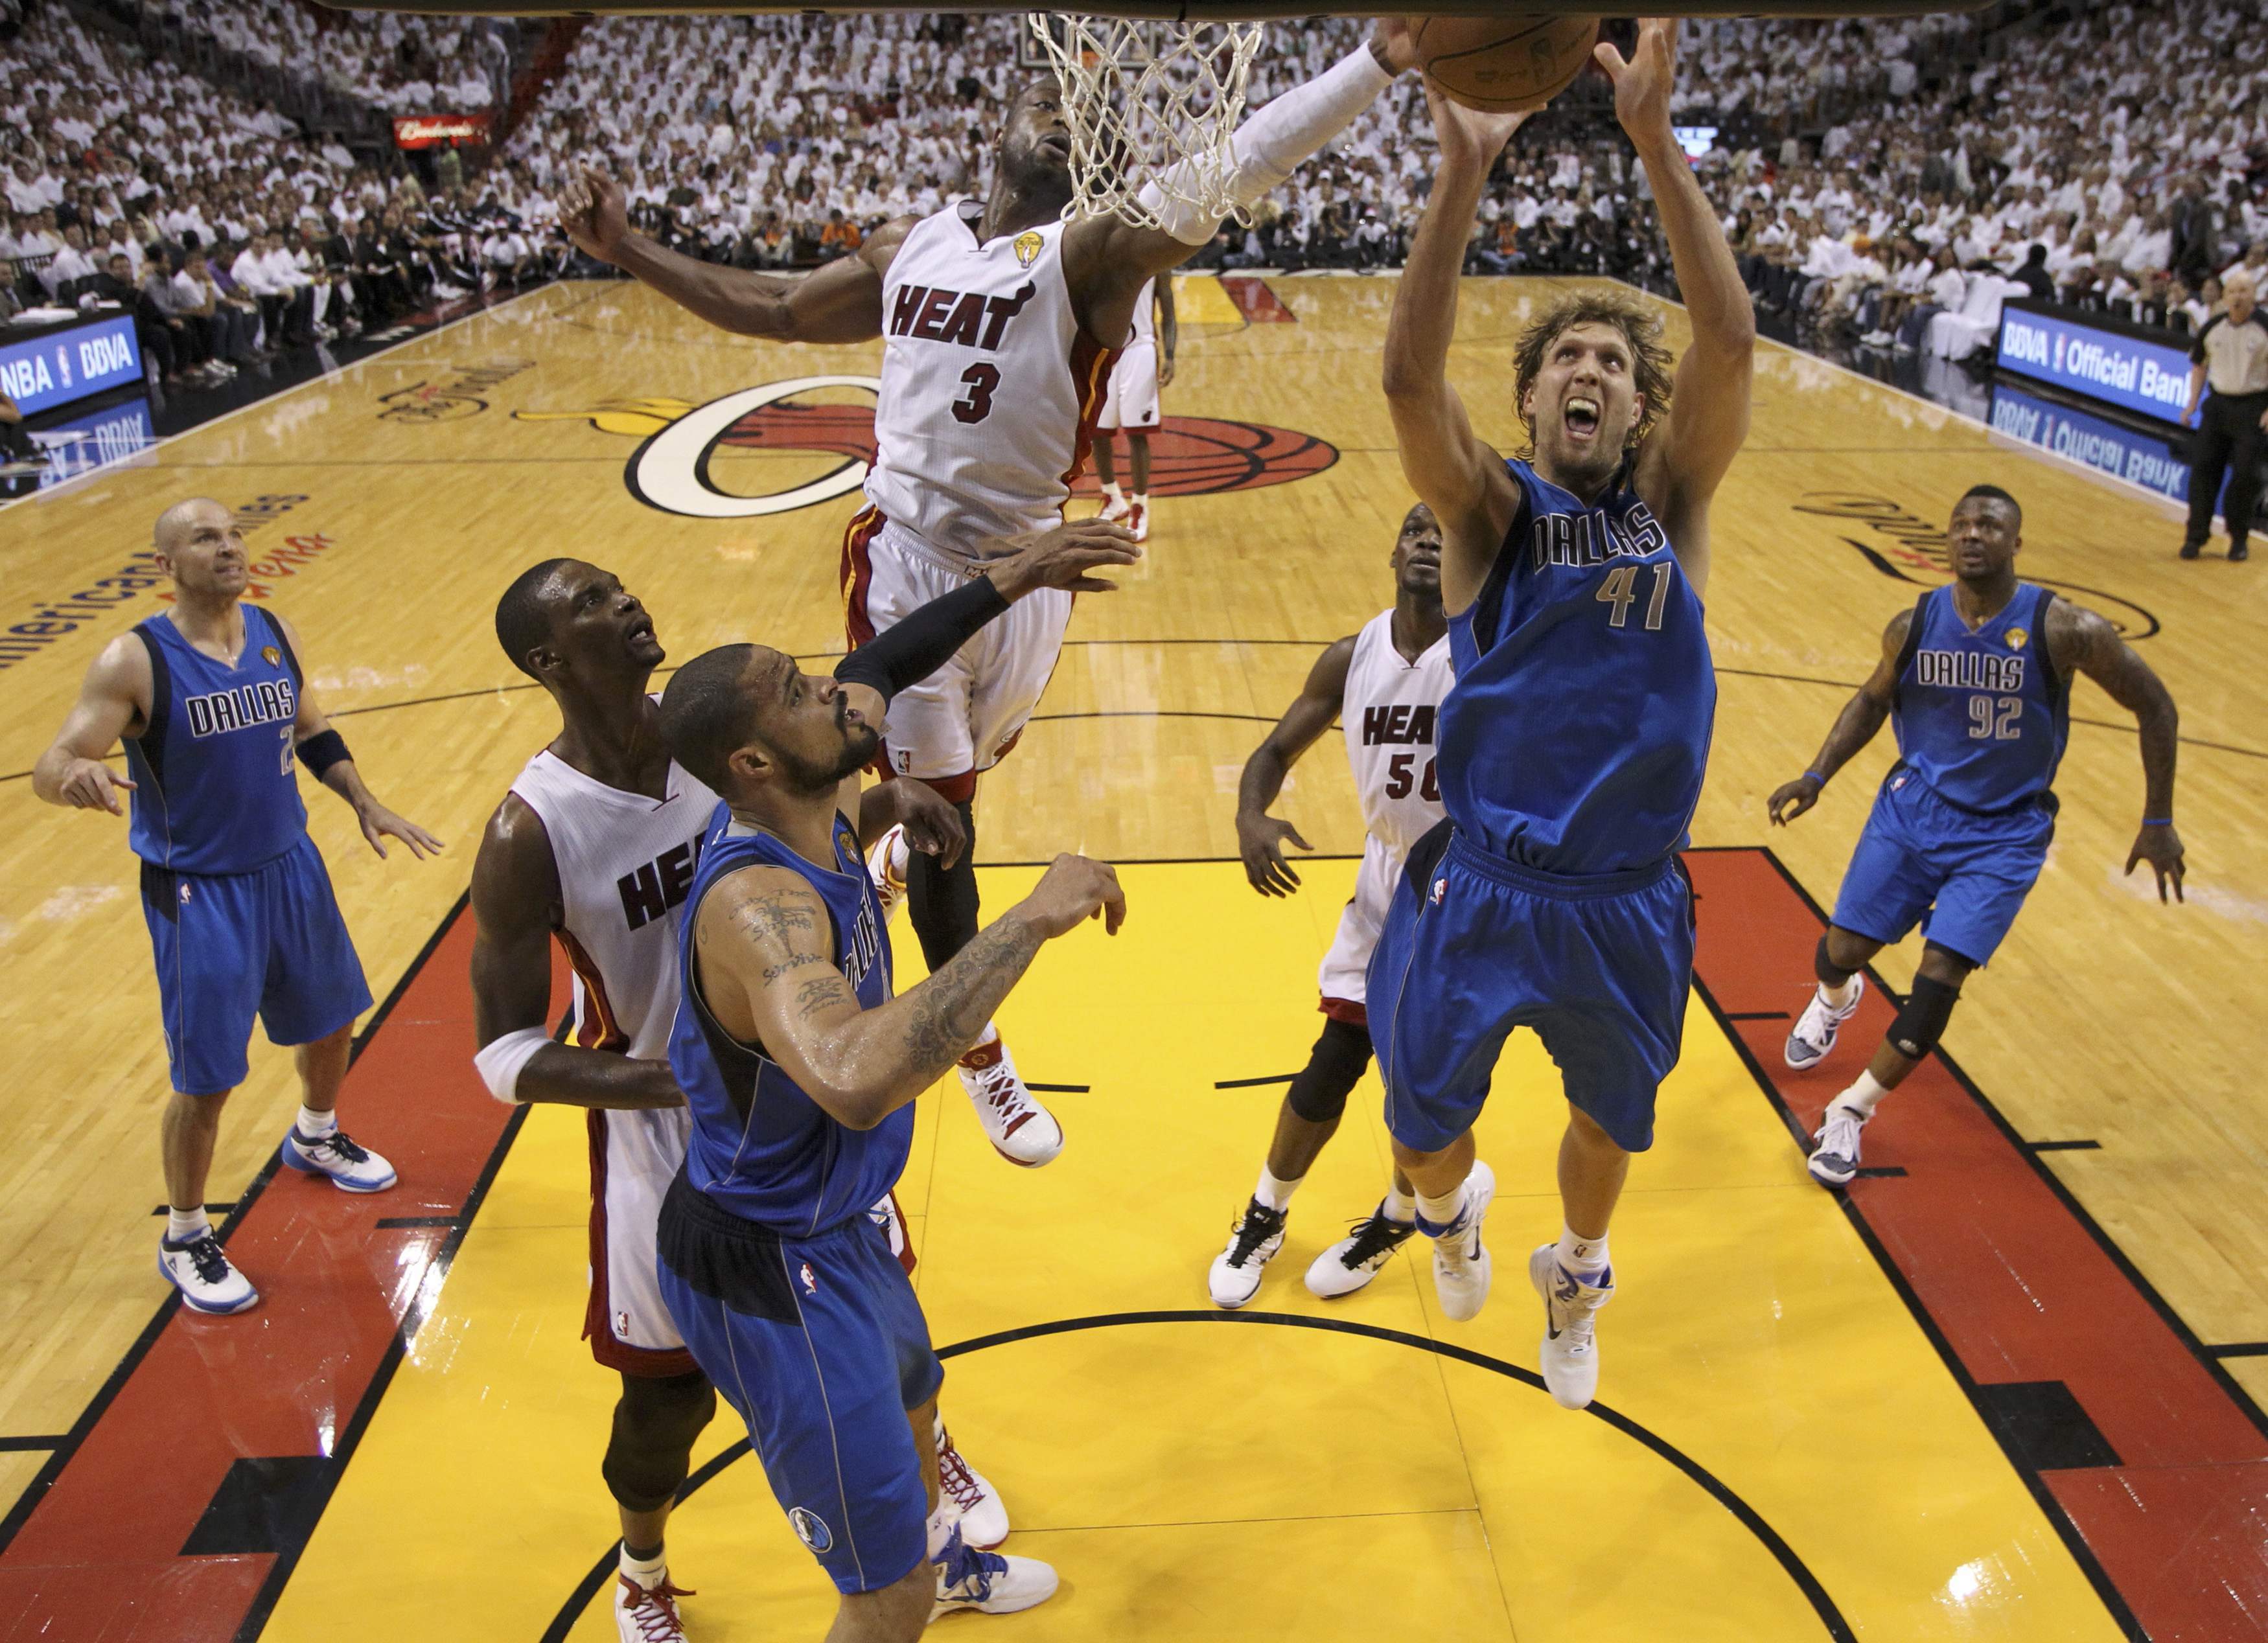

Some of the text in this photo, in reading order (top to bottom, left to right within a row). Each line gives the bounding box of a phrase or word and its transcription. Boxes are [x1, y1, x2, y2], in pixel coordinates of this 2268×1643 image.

[890, 280, 1036, 351] HEAT
[0, 332, 133, 400] NBA BBVA
[2003, 322, 2048, 367] BBVA
[2066, 339, 2138, 392] Official
[951, 362, 1001, 424] 3
[1532, 502, 1666, 575] DALLAS
[1596, 562, 1671, 630] 41
[1917, 649, 2025, 693] DALLAS
[185, 678, 295, 738] DALLAS
[1363, 705, 1440, 746] HEA
[1969, 695, 2023, 740] 92
[280, 724, 294, 777] 2
